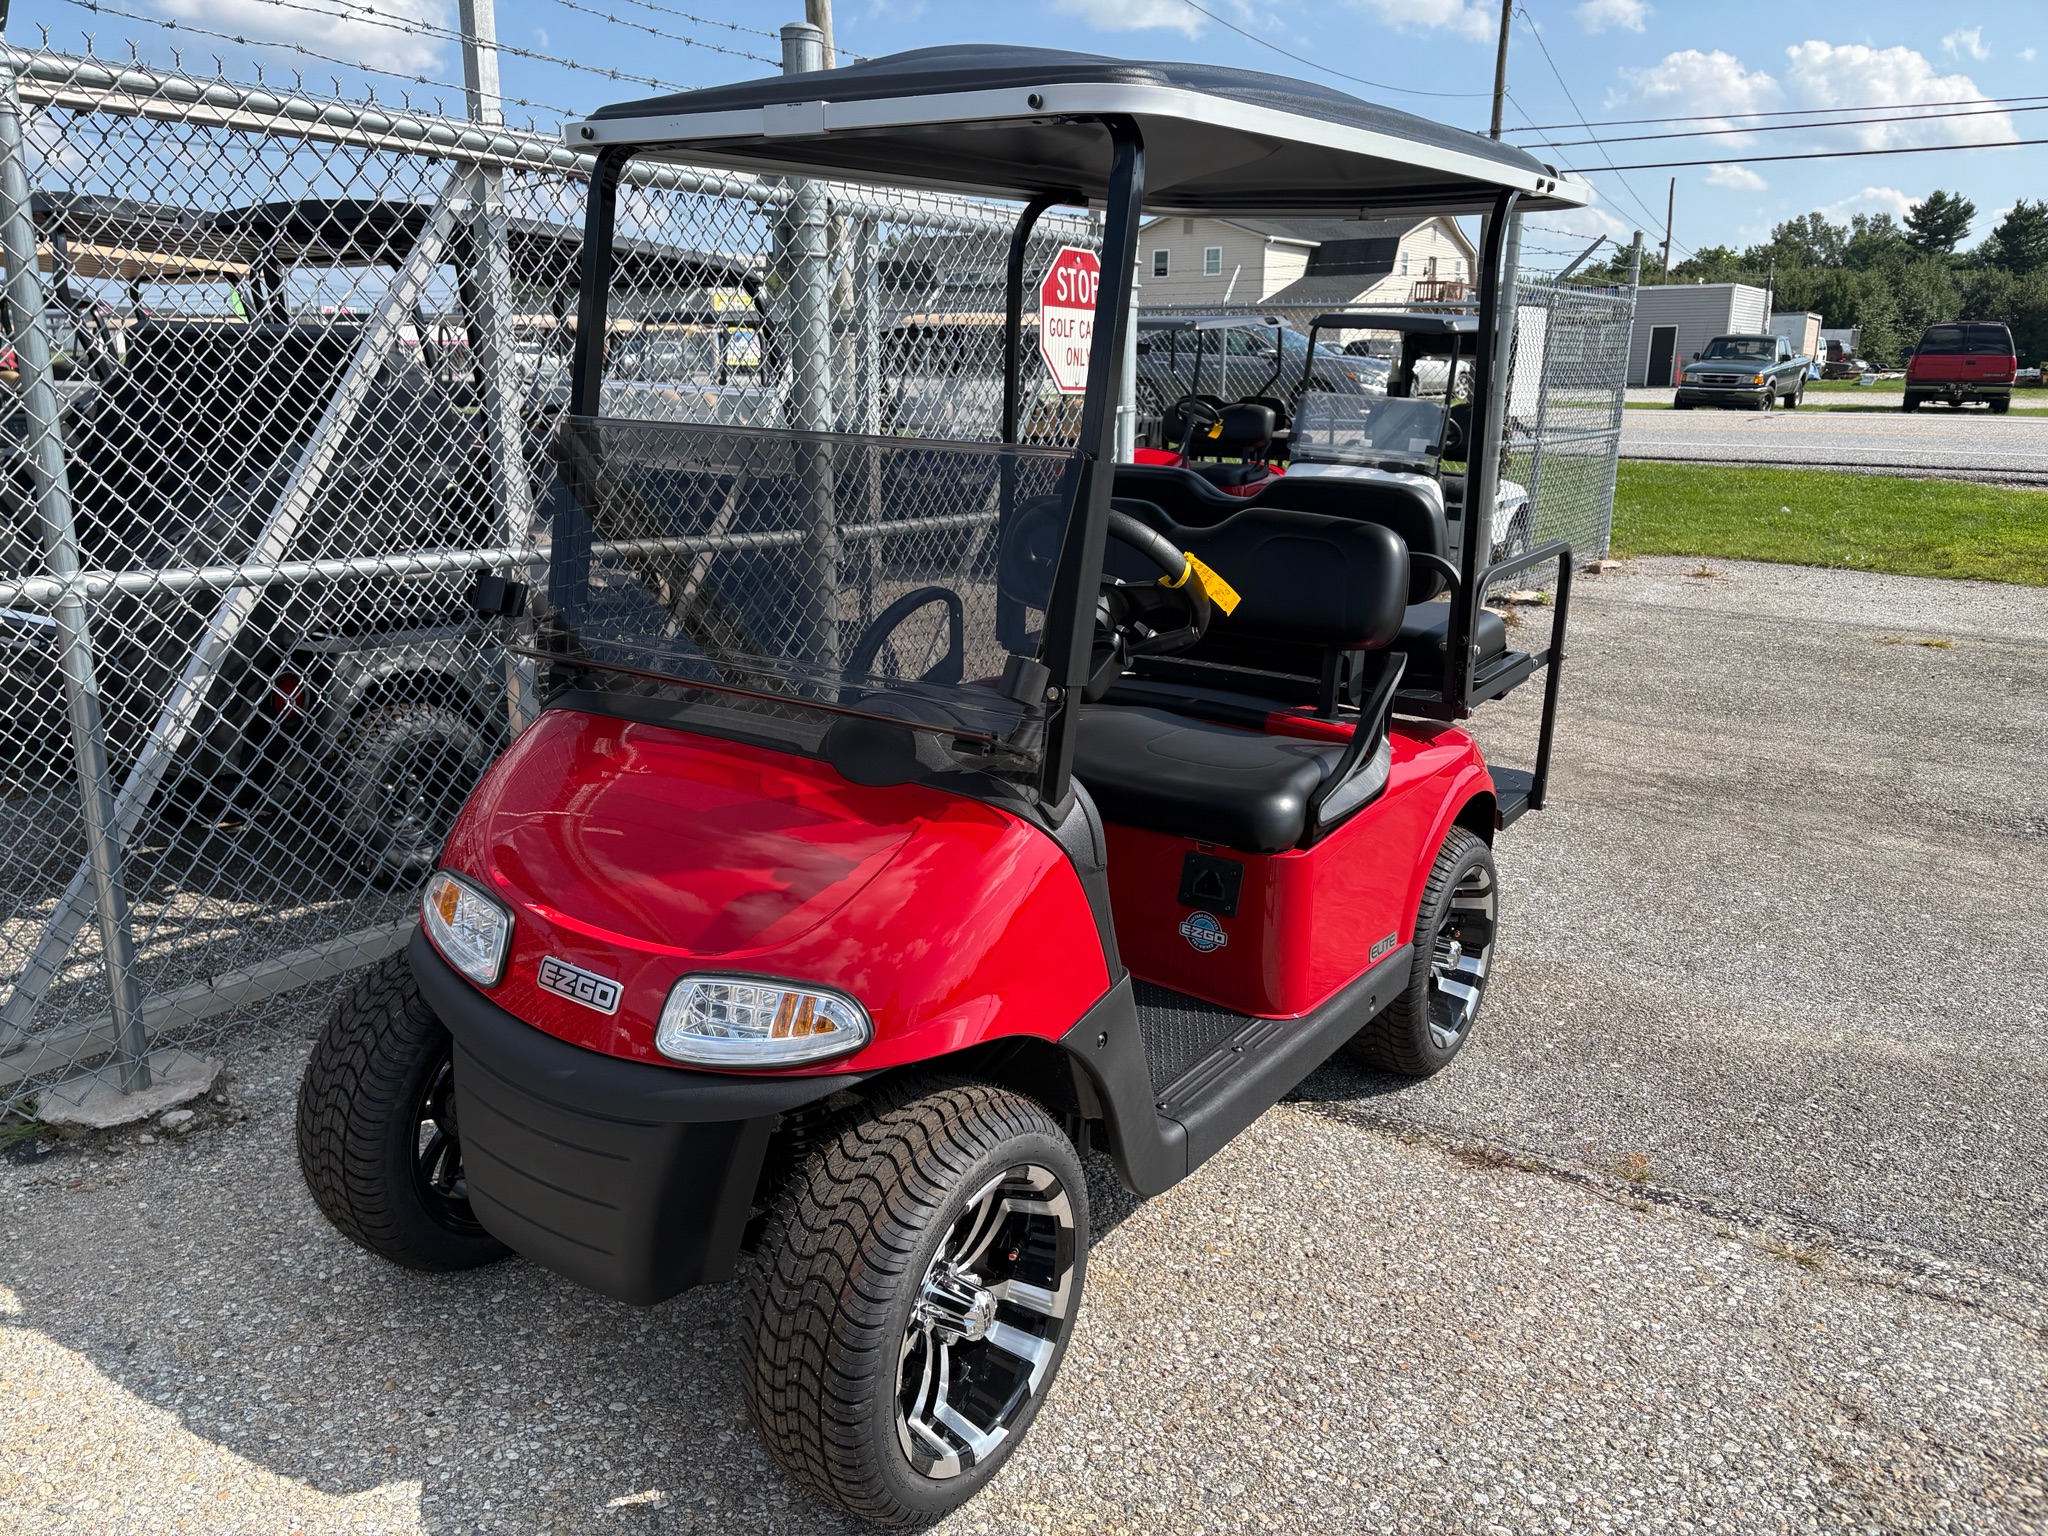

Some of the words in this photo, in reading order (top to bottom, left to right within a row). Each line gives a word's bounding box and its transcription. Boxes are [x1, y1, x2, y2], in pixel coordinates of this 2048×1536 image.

[1057, 266, 1099, 304] STOP
[1050, 318, 1075, 338] GOLF
[540, 962, 615, 1008] EZGO
